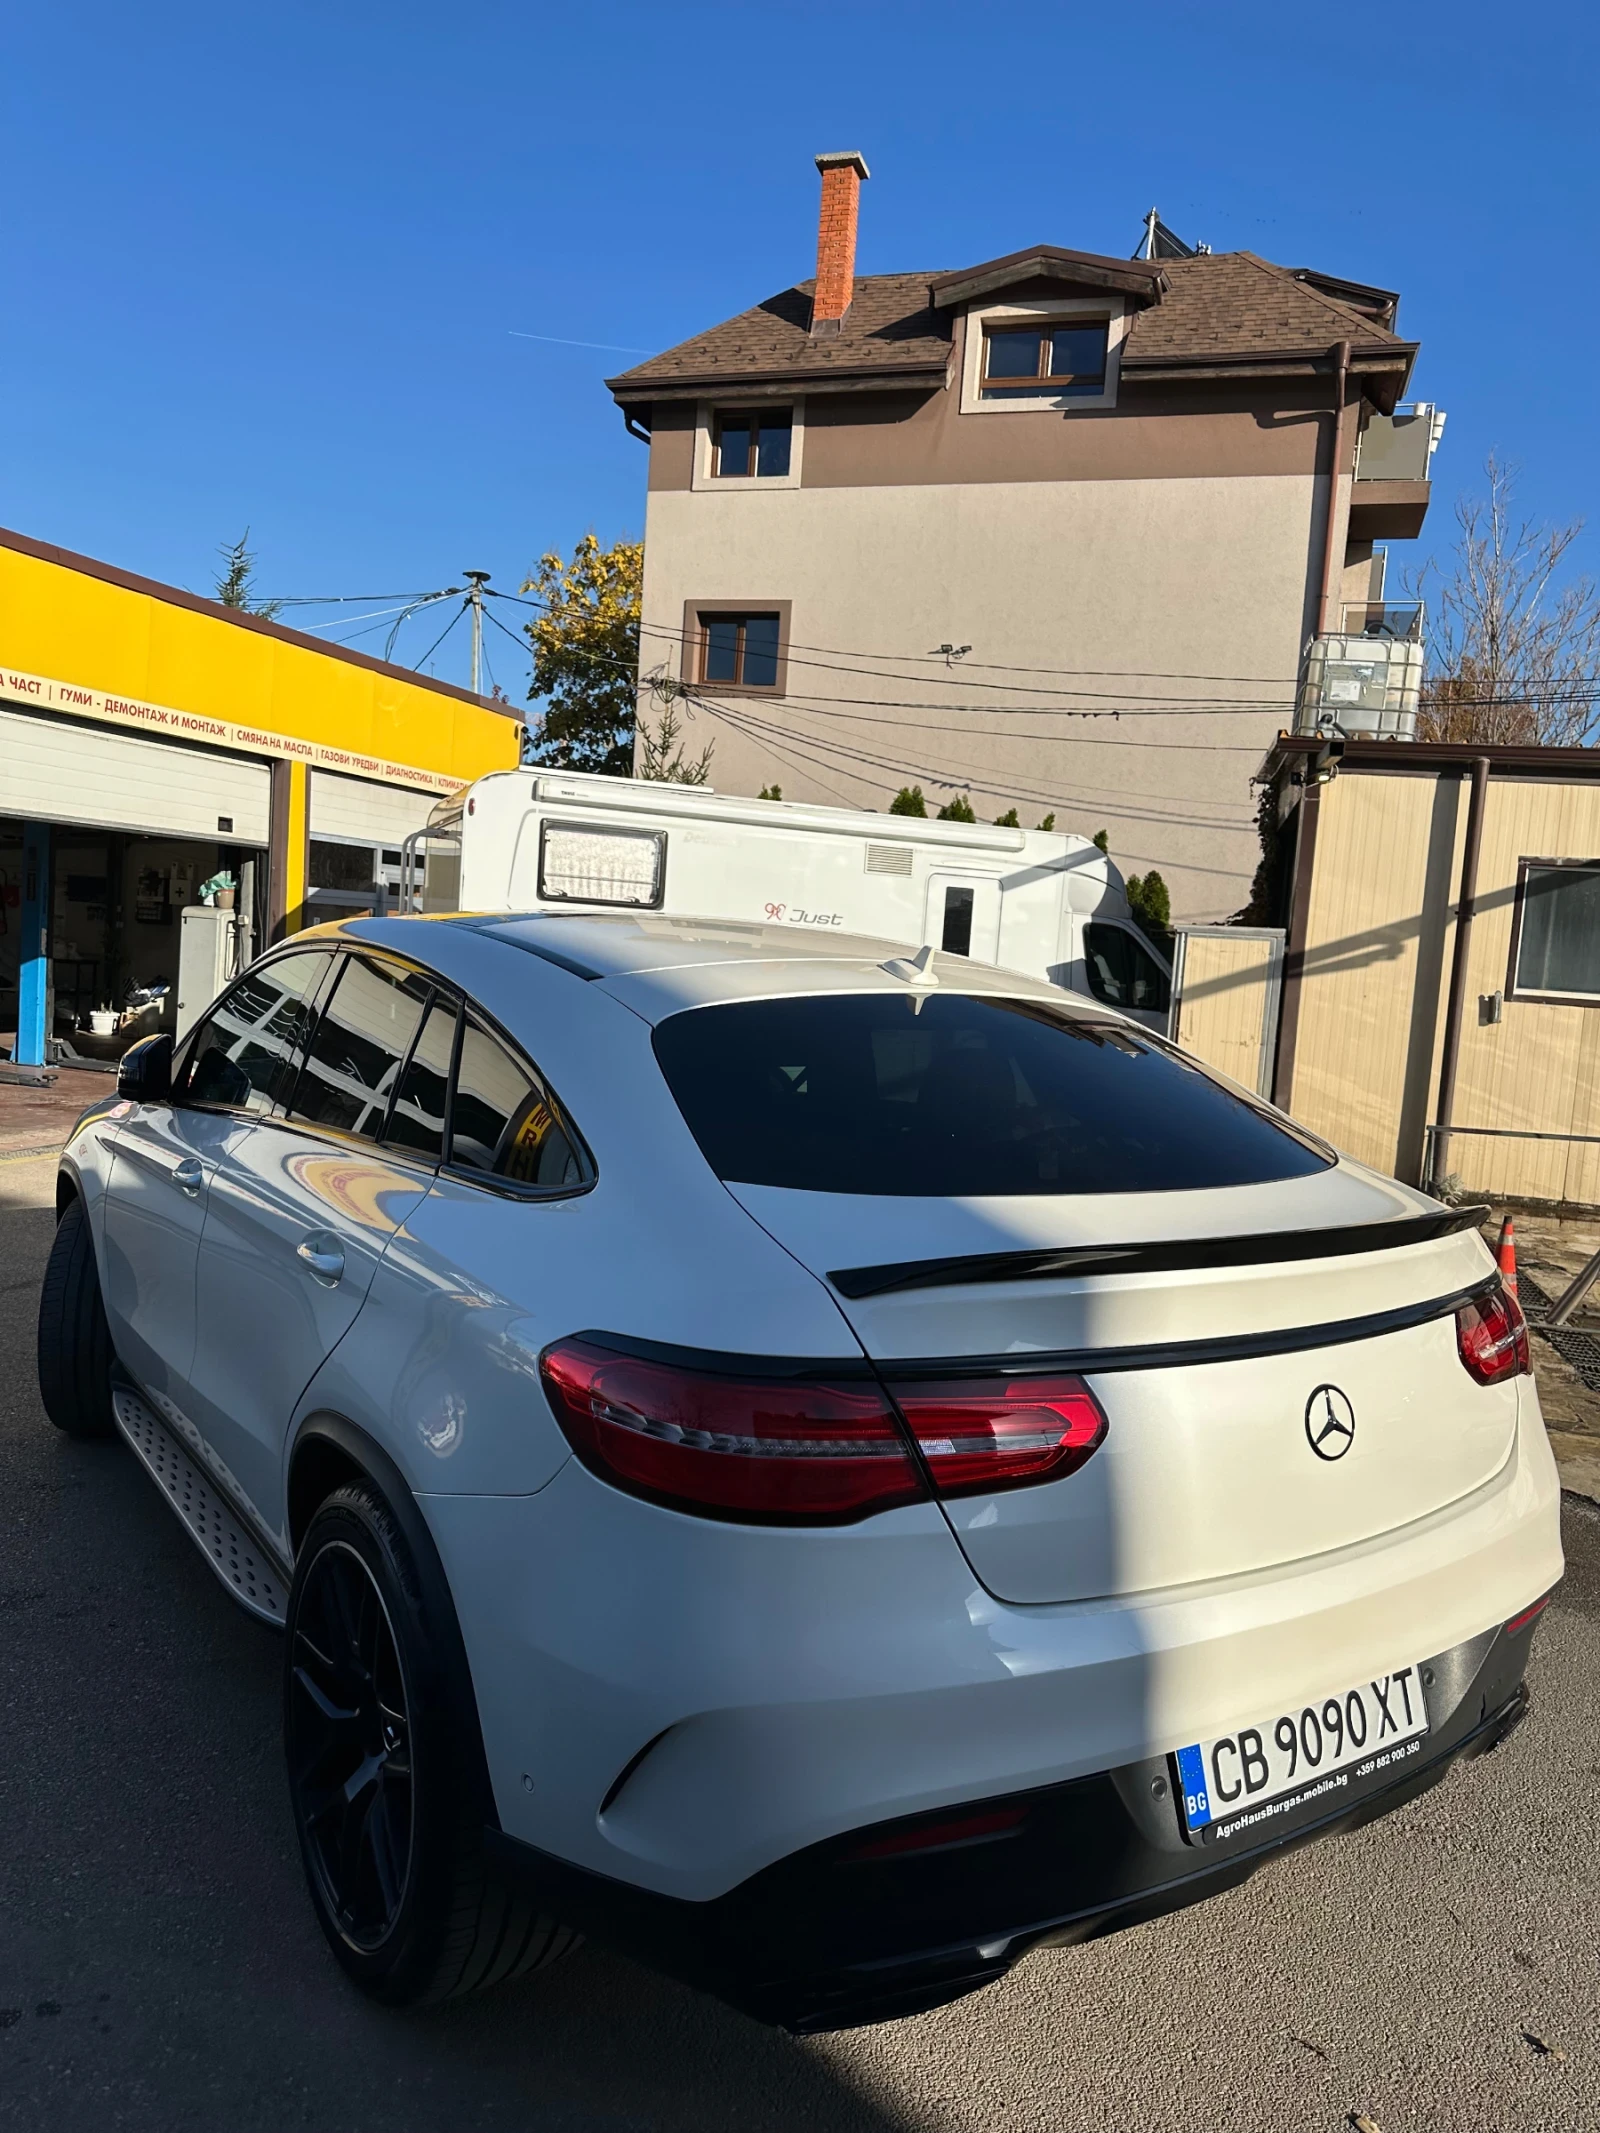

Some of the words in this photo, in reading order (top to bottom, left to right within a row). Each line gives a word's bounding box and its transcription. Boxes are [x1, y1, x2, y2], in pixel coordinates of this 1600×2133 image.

[9, 676, 41, 694] ЧАСТ
[60, 688, 92, 706] ГУМИ
[104, 699, 168, 724] ДЕМОНТАЖ
[171, 714, 179, 726] И
[181, 717, 226, 737] МОНТАЖ
[237, 730, 268, 746] СМЯНА
[269, 737, 281, 749] НА
[283, 740, 313, 756] МАСЛА
[320, 749, 350, 765] ГАЗОВИ
[352, 756, 379, 772] УРЕДБИ
[385, 765, 433, 785] ДИАГНОСТИКА
[789, 908, 844, 926] Just
[1211, 1728, 1269, 1803] CB
[1274, 1689, 1367, 1778] 9090
[1370, 1667, 1413, 1739] XT
[1187, 1792, 1207, 1816] BG
[1216, 1772, 1348, 1839] AgroHausBurgas.mobile.bg
[1356, 1761, 1375, 1776] +359
[1376, 1754, 1390, 1768] 882
[1391, 1747, 1405, 1762] 900
[1406, 1741, 1420, 1755] 350
